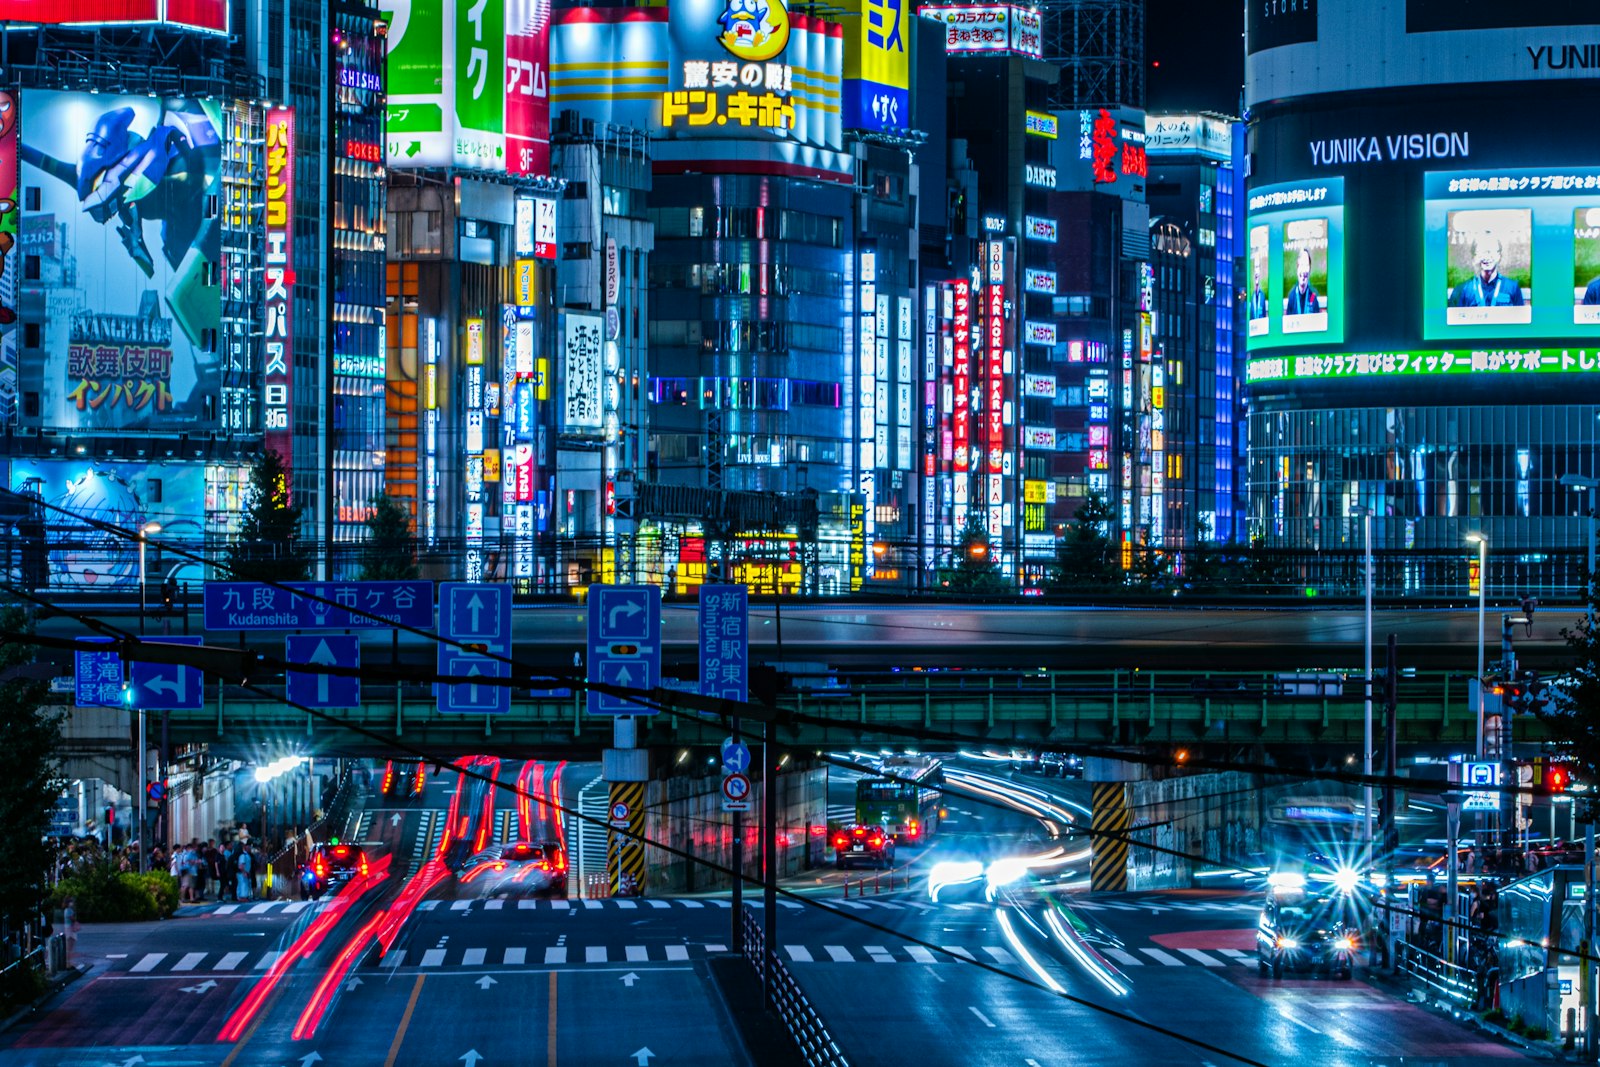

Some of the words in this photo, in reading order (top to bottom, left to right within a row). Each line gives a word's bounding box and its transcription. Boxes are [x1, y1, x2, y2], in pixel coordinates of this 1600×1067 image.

[956, 12, 997, 23] カラオケ
[947, 25, 1005, 45] まねきねこ
[341, 68, 382, 92] SHISHA
[507, 57, 547, 98] アコム
[348, 142, 380, 162] POKER
[519, 148, 534, 171] 3F
[1309, 136, 1382, 166] YUNIKA
[1386, 131, 1470, 160] VISION
[266, 120, 291, 226] パチンコ
[1026, 165, 1057, 188] DARTS
[70, 315, 172, 342] EVANGELION
[991, 285, 1001, 361] KARAOKE
[68, 345, 173, 378] 歌舞伎町
[67, 378, 173, 410] インパクト
[991, 381, 1000, 433] PARTY
[222, 587, 303, 610] 九段下
[315, 602, 325, 612] 4
[228, 613, 298, 625] Kudanshita
[703, 594, 720, 653] Shinjuku
[721, 591, 742, 702] 新宿駅東口
